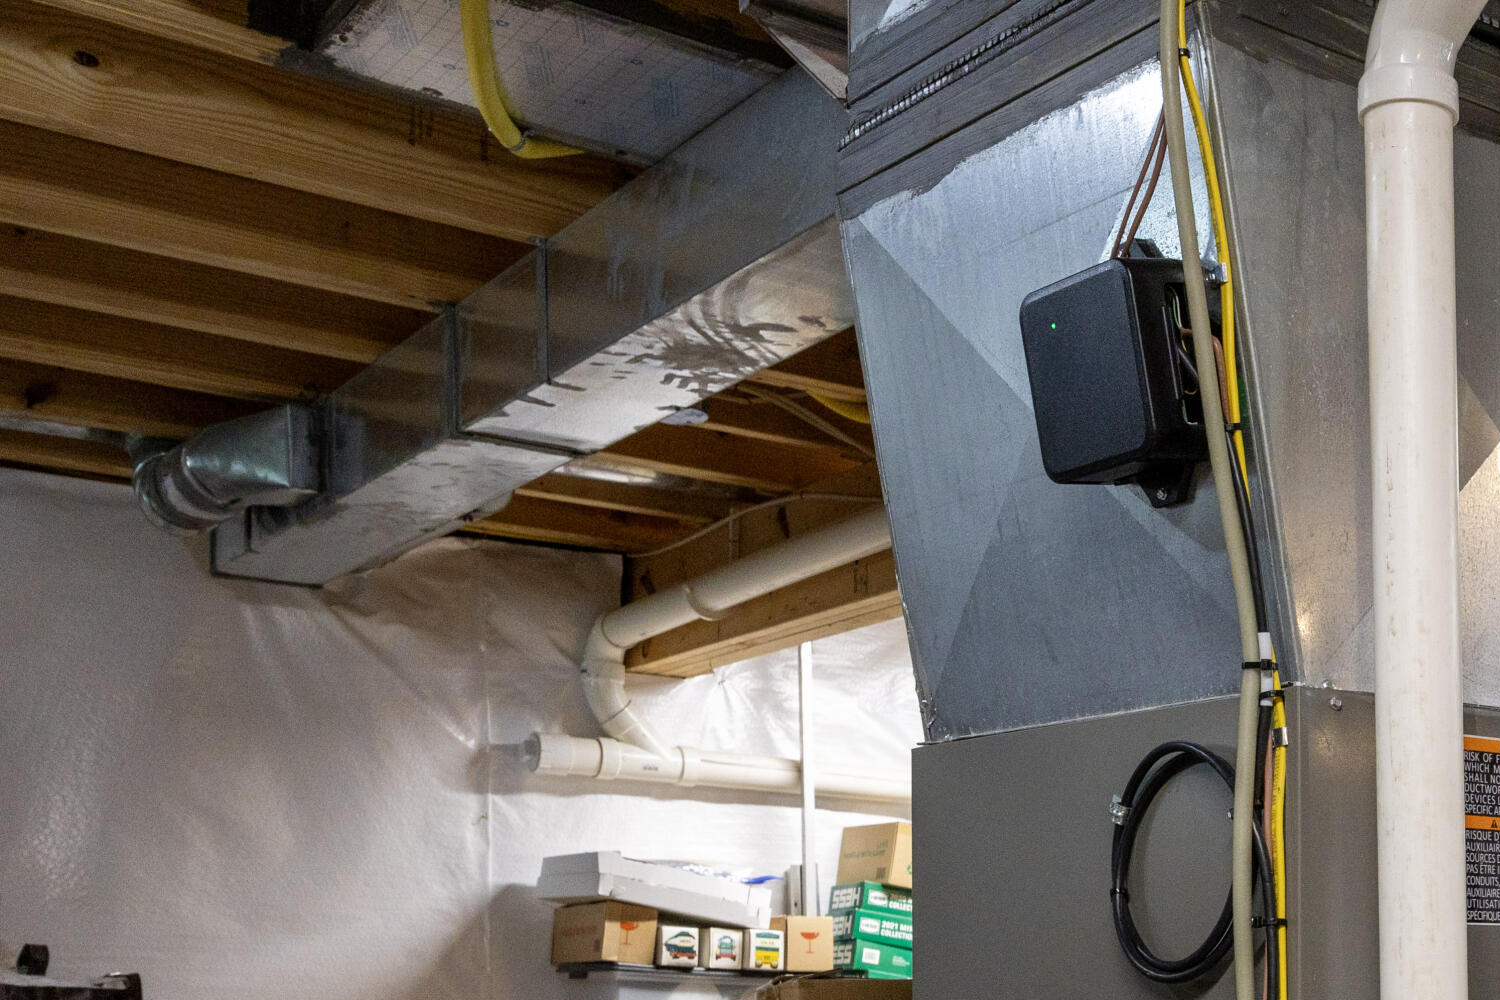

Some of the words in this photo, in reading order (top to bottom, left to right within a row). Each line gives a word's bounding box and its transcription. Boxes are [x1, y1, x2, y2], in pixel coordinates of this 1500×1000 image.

[1464, 751, 1480, 760] RISK
[1483, 753, 1493, 763] OF
[1465, 762, 1490, 773] WHICH
[1465, 772, 1488, 784] SHALL
[1465, 793, 1496, 805] DEVICES
[1465, 803, 1493, 815] SPECIFIC
[1466, 830, 1492, 841] RISQUE
[1466, 853, 1496, 863] SOURCES
[1467, 864, 1478, 874] PAS
[881, 921, 898, 930] 2021
